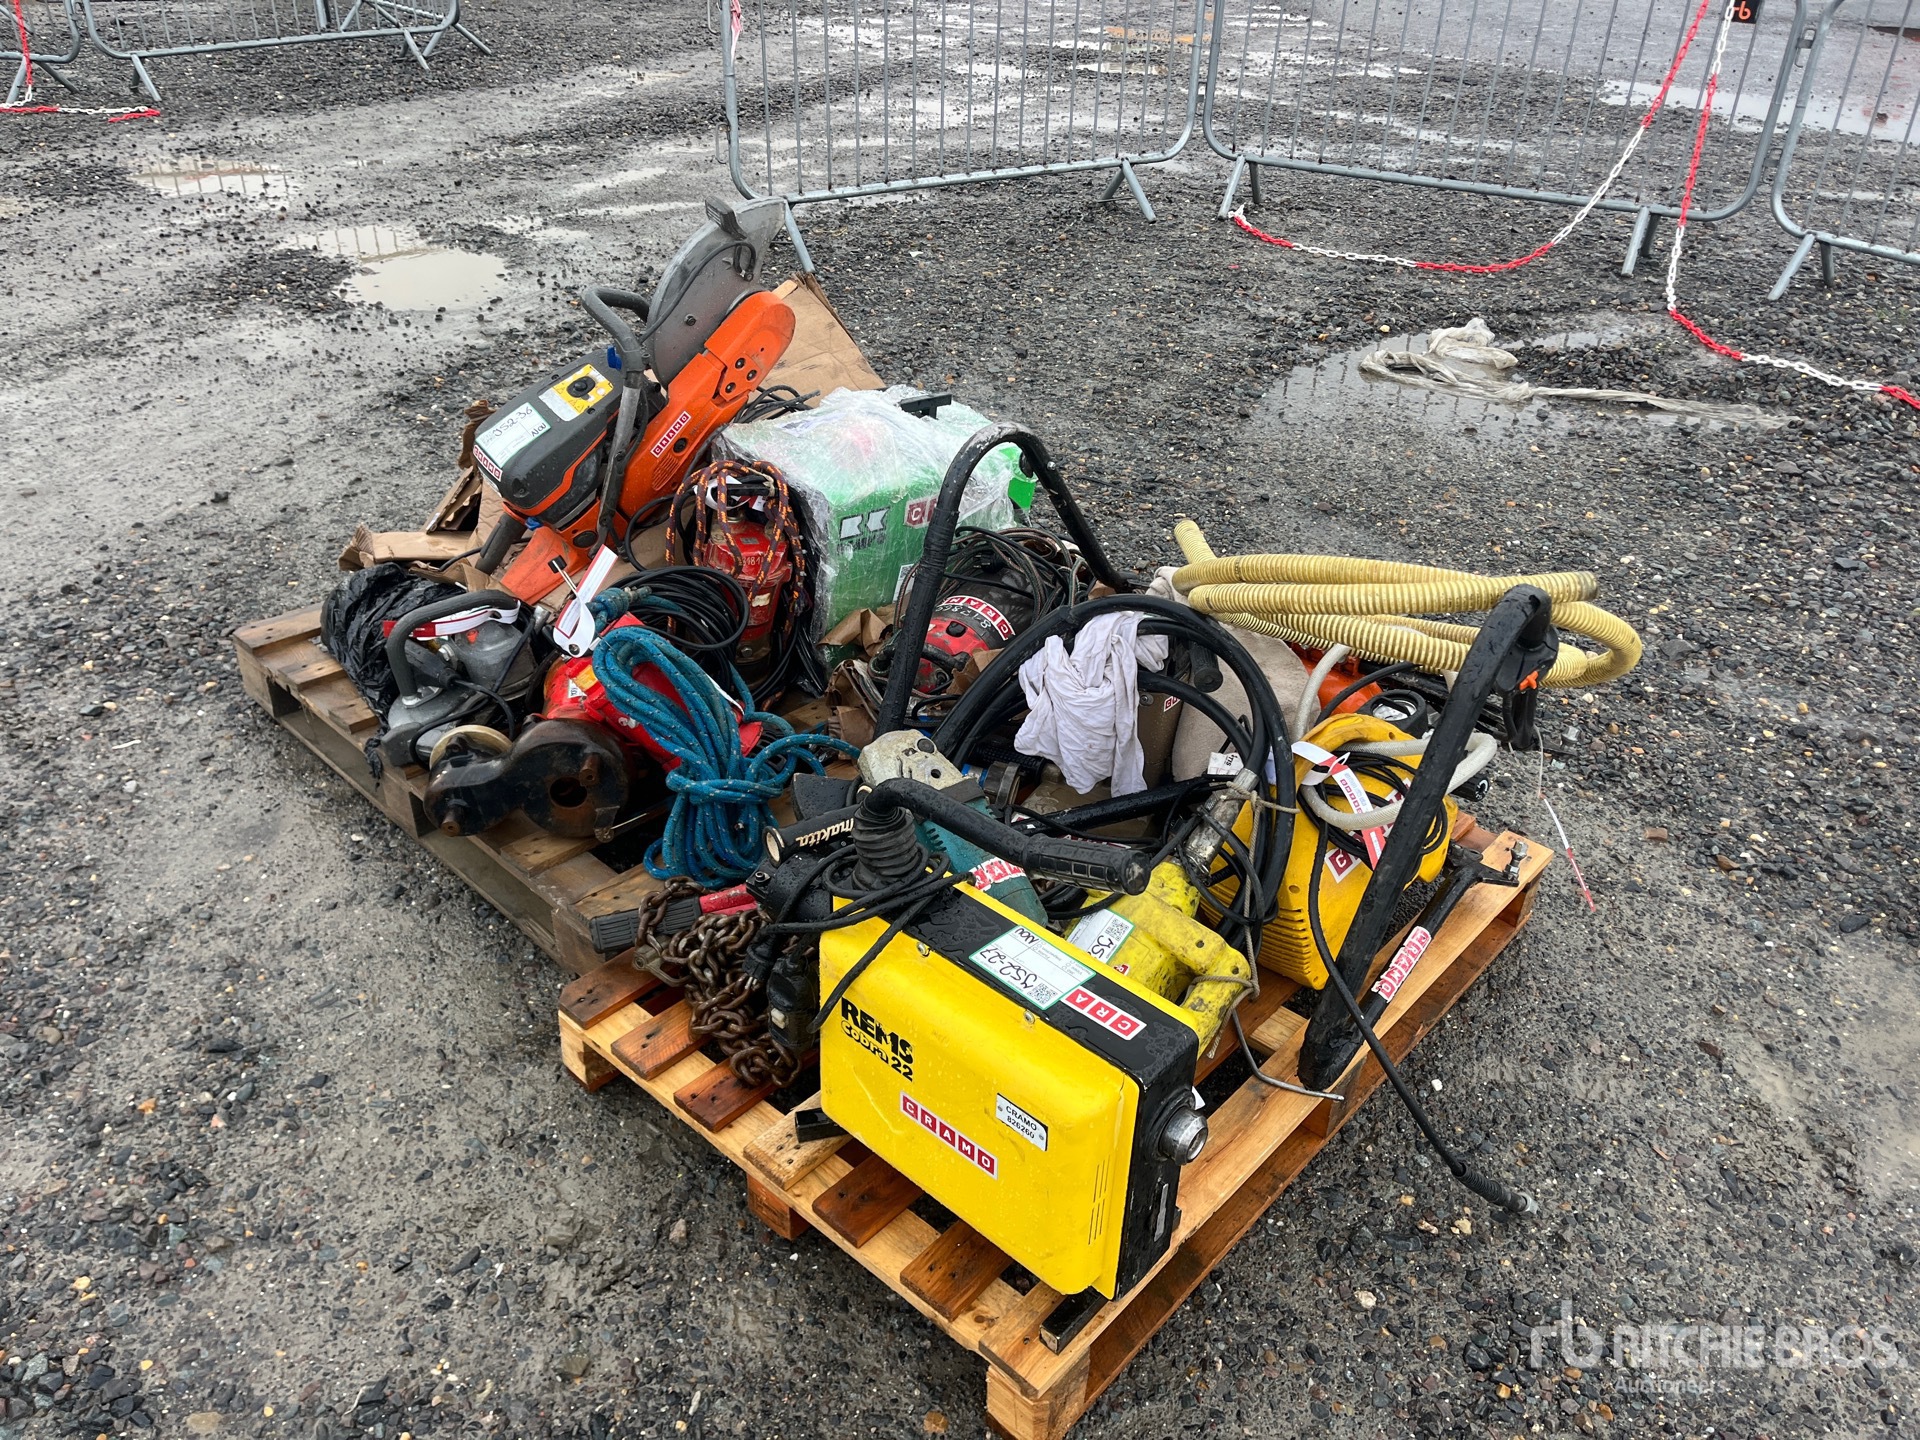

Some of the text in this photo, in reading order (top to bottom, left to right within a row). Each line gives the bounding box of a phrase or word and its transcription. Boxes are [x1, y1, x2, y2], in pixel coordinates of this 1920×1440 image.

[653, 413, 689, 455] CRAMO
[795, 818, 854, 847] makita
[841, 996, 914, 1065] REMS
[890, 1056, 914, 1081] 22
[1005, 1105, 1038, 1131] CRAMO
[1006, 1115, 1035, 1140] 826260
[904, 1098, 993, 1172] CRAMO
